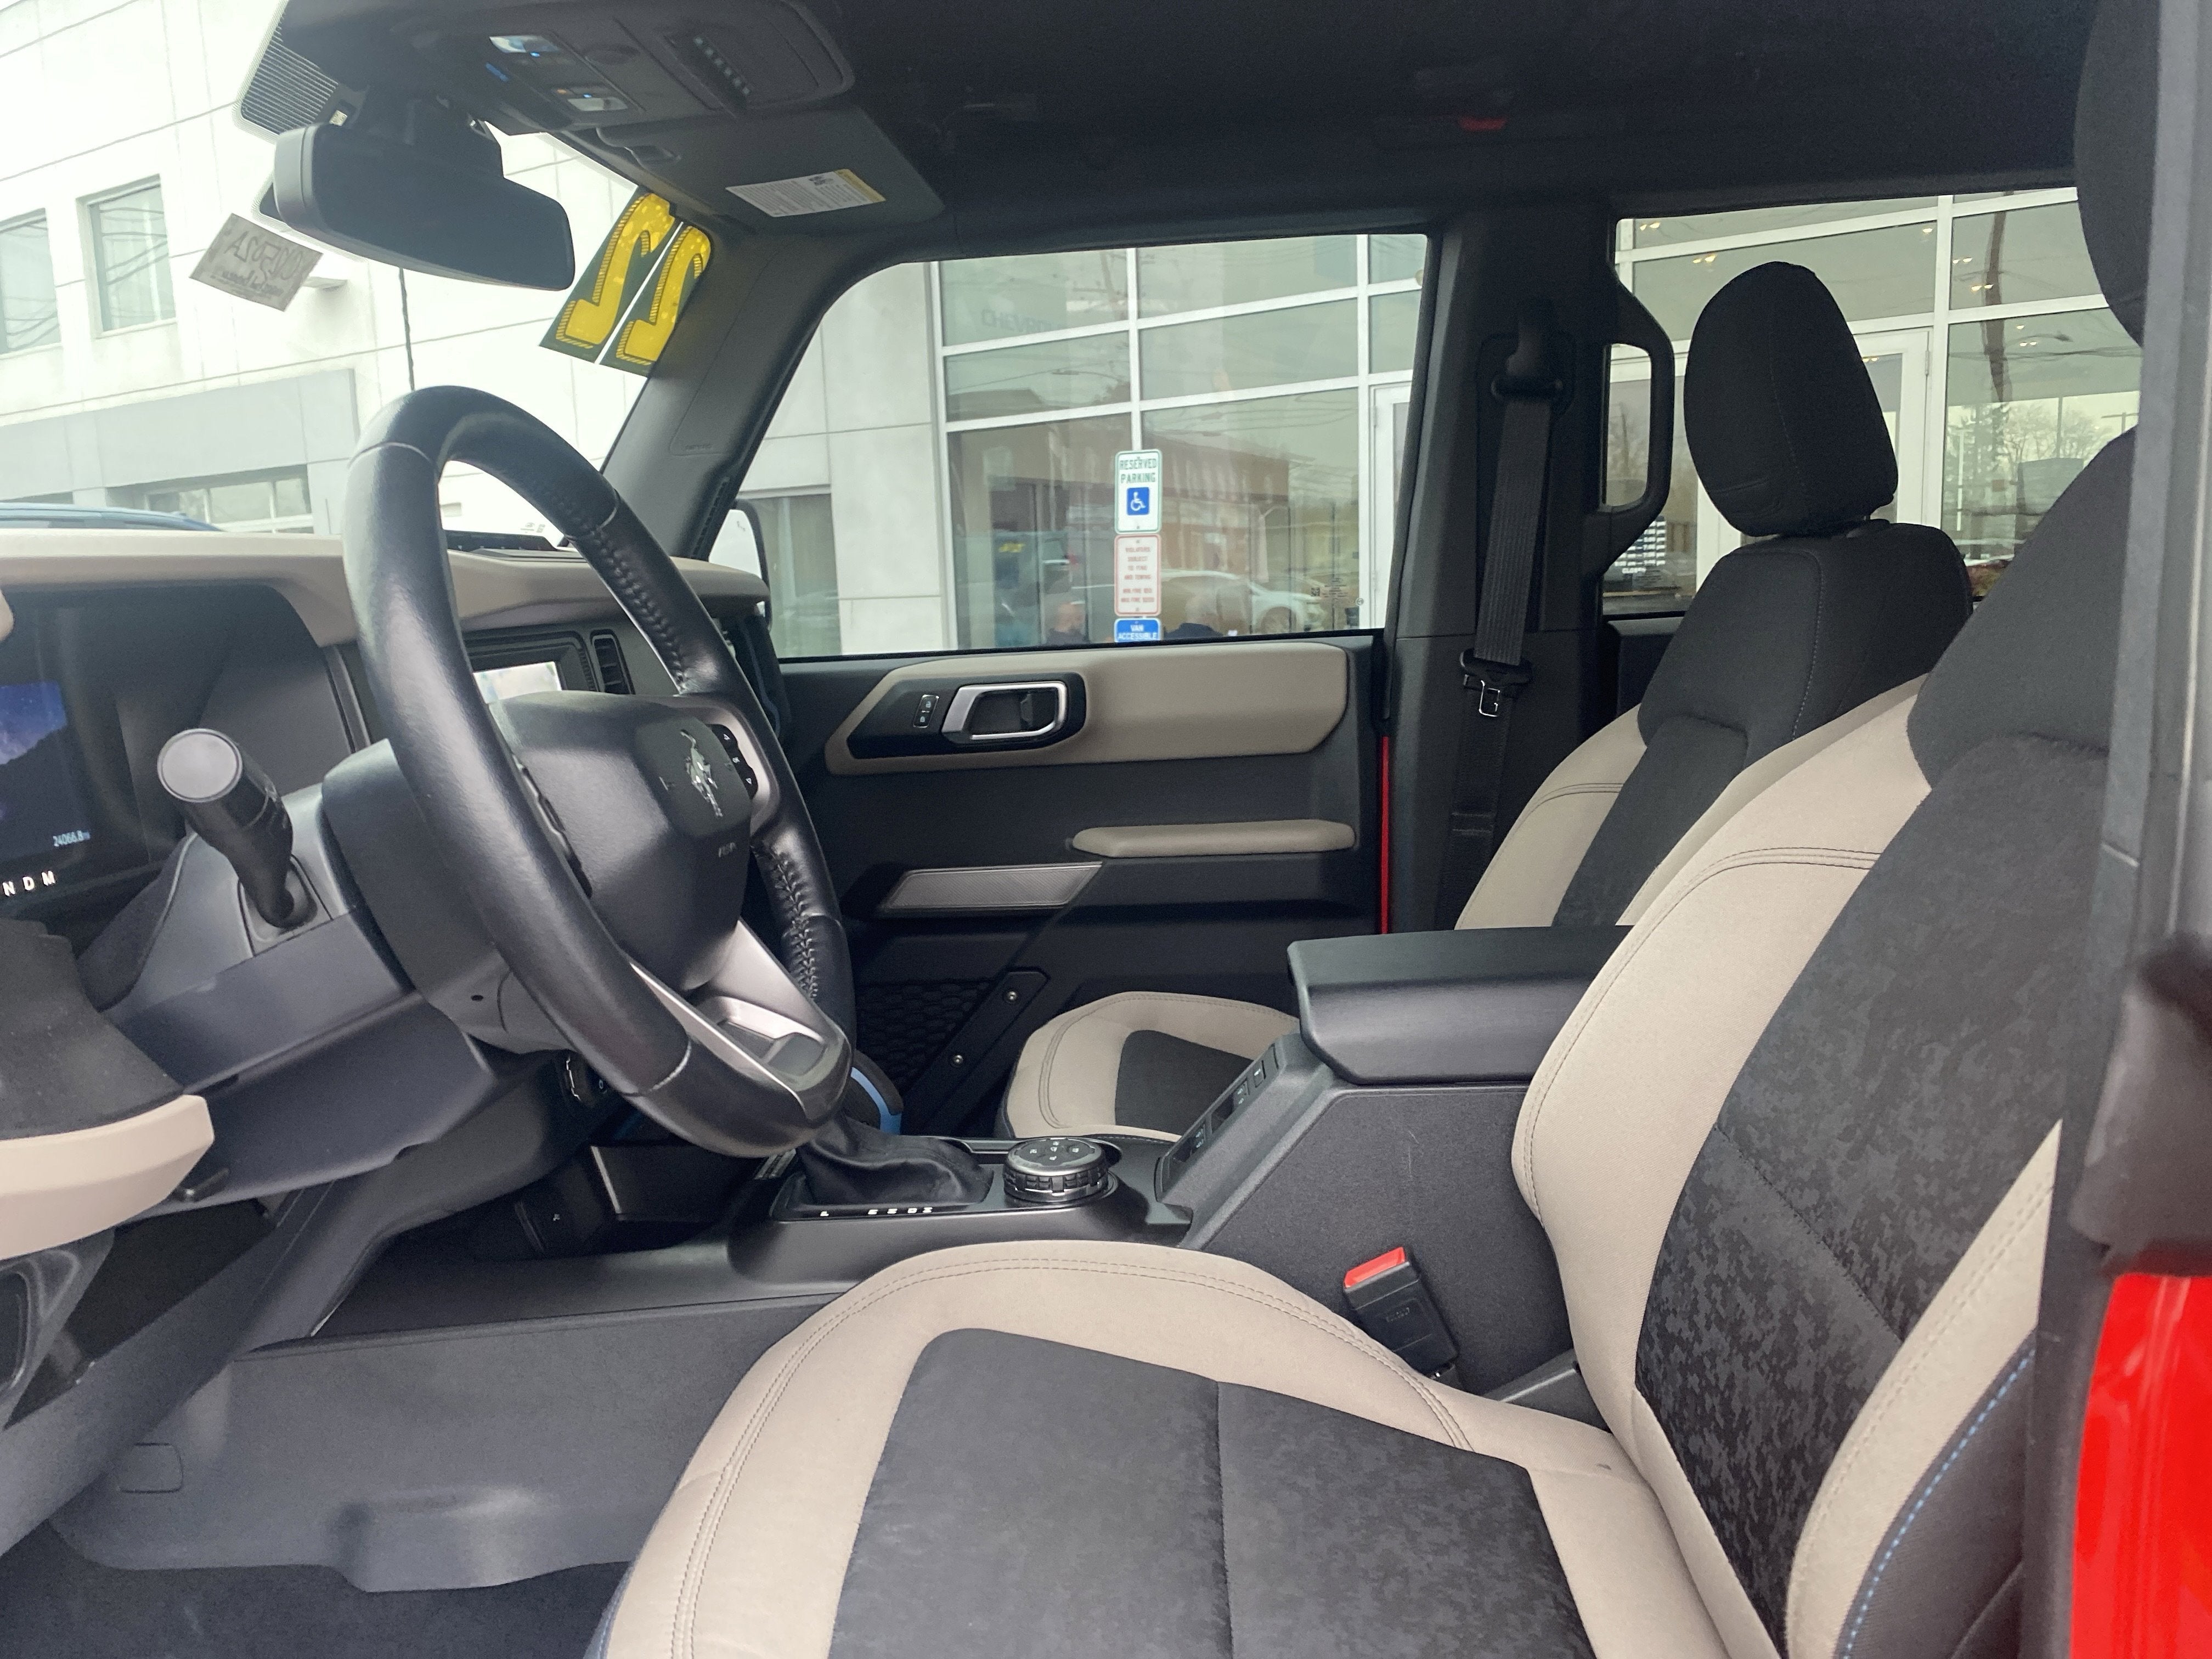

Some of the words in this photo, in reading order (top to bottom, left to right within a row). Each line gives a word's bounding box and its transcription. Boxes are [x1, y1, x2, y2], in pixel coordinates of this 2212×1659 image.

[1119, 459, 1156, 470] RESERVED
[1120, 473, 1156, 483] PARKING
[1130, 624, 1144, 632] VAN
[1118, 632, 1158, 640] ACCESSIBLE
[2, 881, 16, 896] N
[22, 876, 36, 891] D
[41, 870, 57, 886] M
